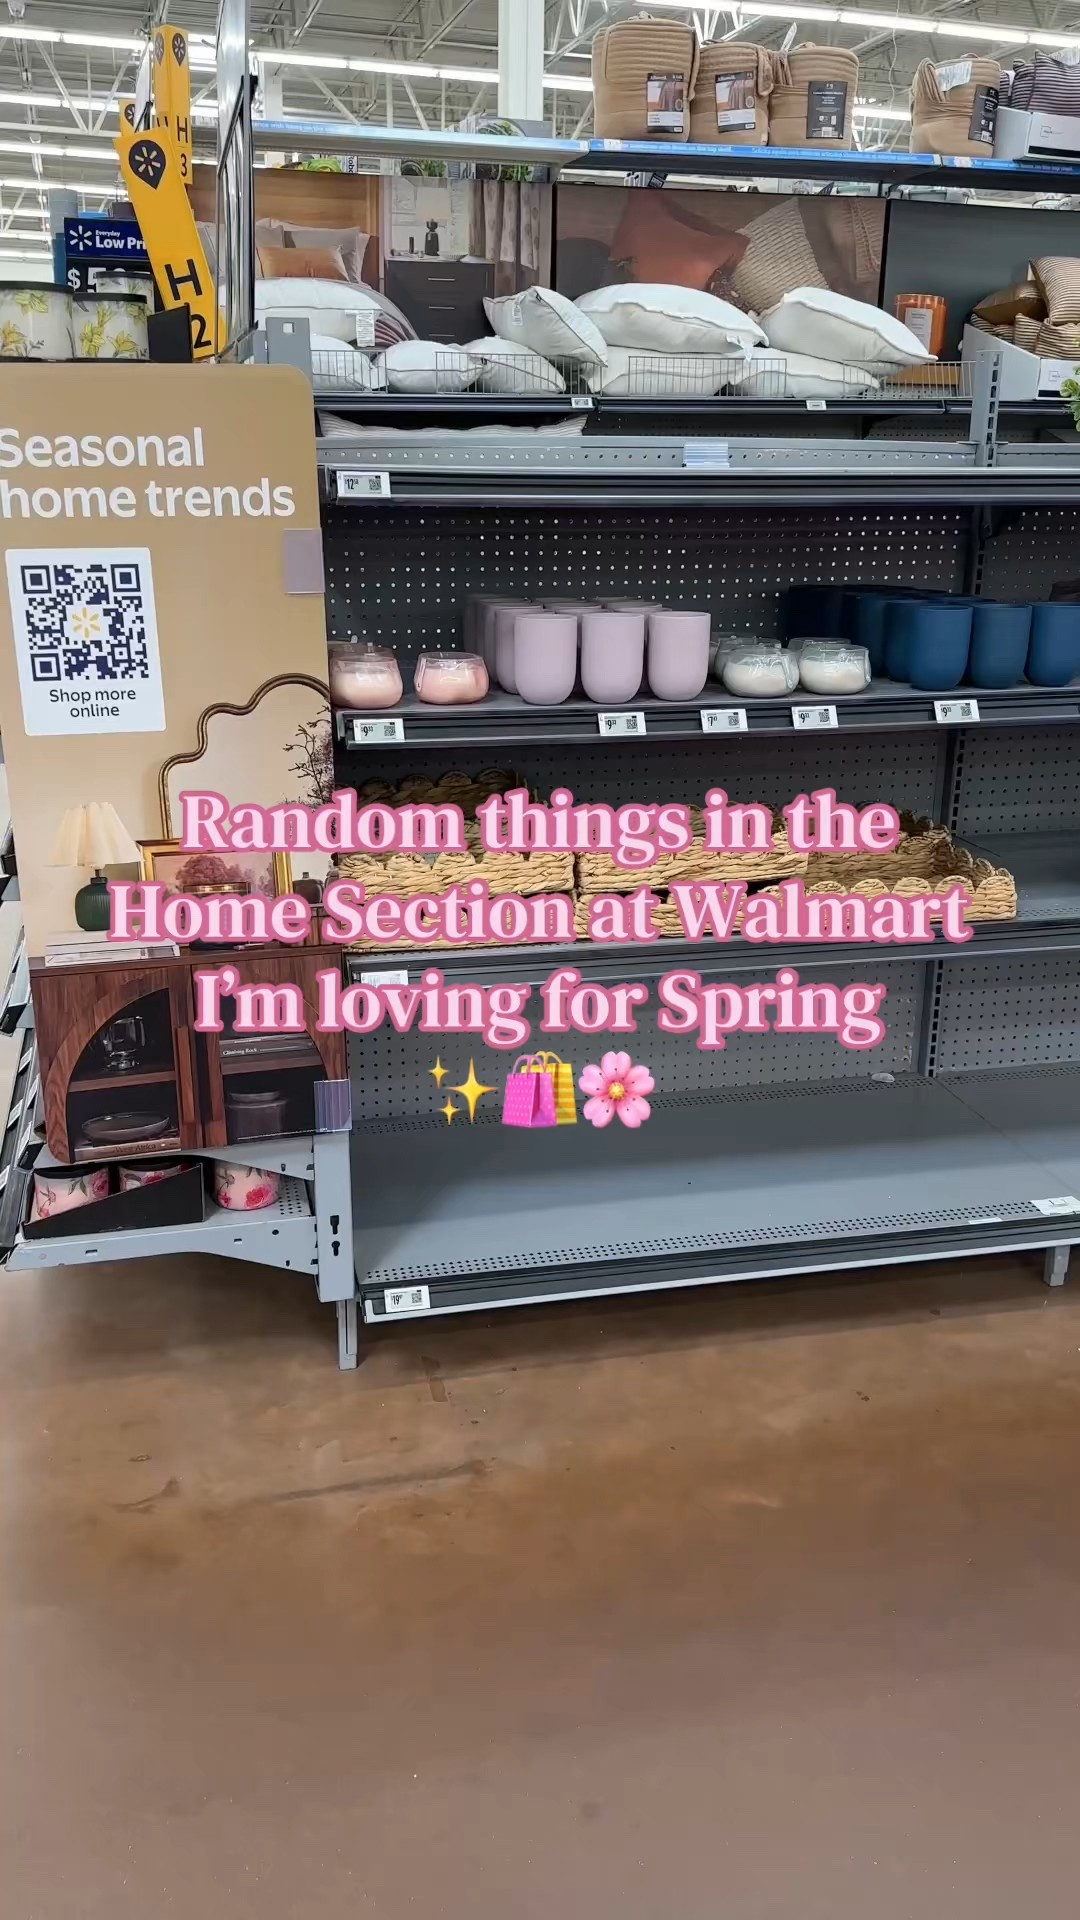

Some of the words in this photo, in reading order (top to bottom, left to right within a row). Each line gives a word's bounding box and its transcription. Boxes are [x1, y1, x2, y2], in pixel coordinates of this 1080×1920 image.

[175, 115, 189, 145] H
[180, 152, 188, 178] 3
[95, 229, 121, 238] Everyday
[95, 235, 125, 249] Low
[164, 258, 203, 301] H
[190, 312, 212, 350] 2
[0, 426, 206, 469] Seasonal
[0, 479, 137, 519] home
[145, 477, 297, 518] trends
[49, 688, 92, 705] Shop
[95, 688, 137, 701] more
[70, 703, 120, 718] online
